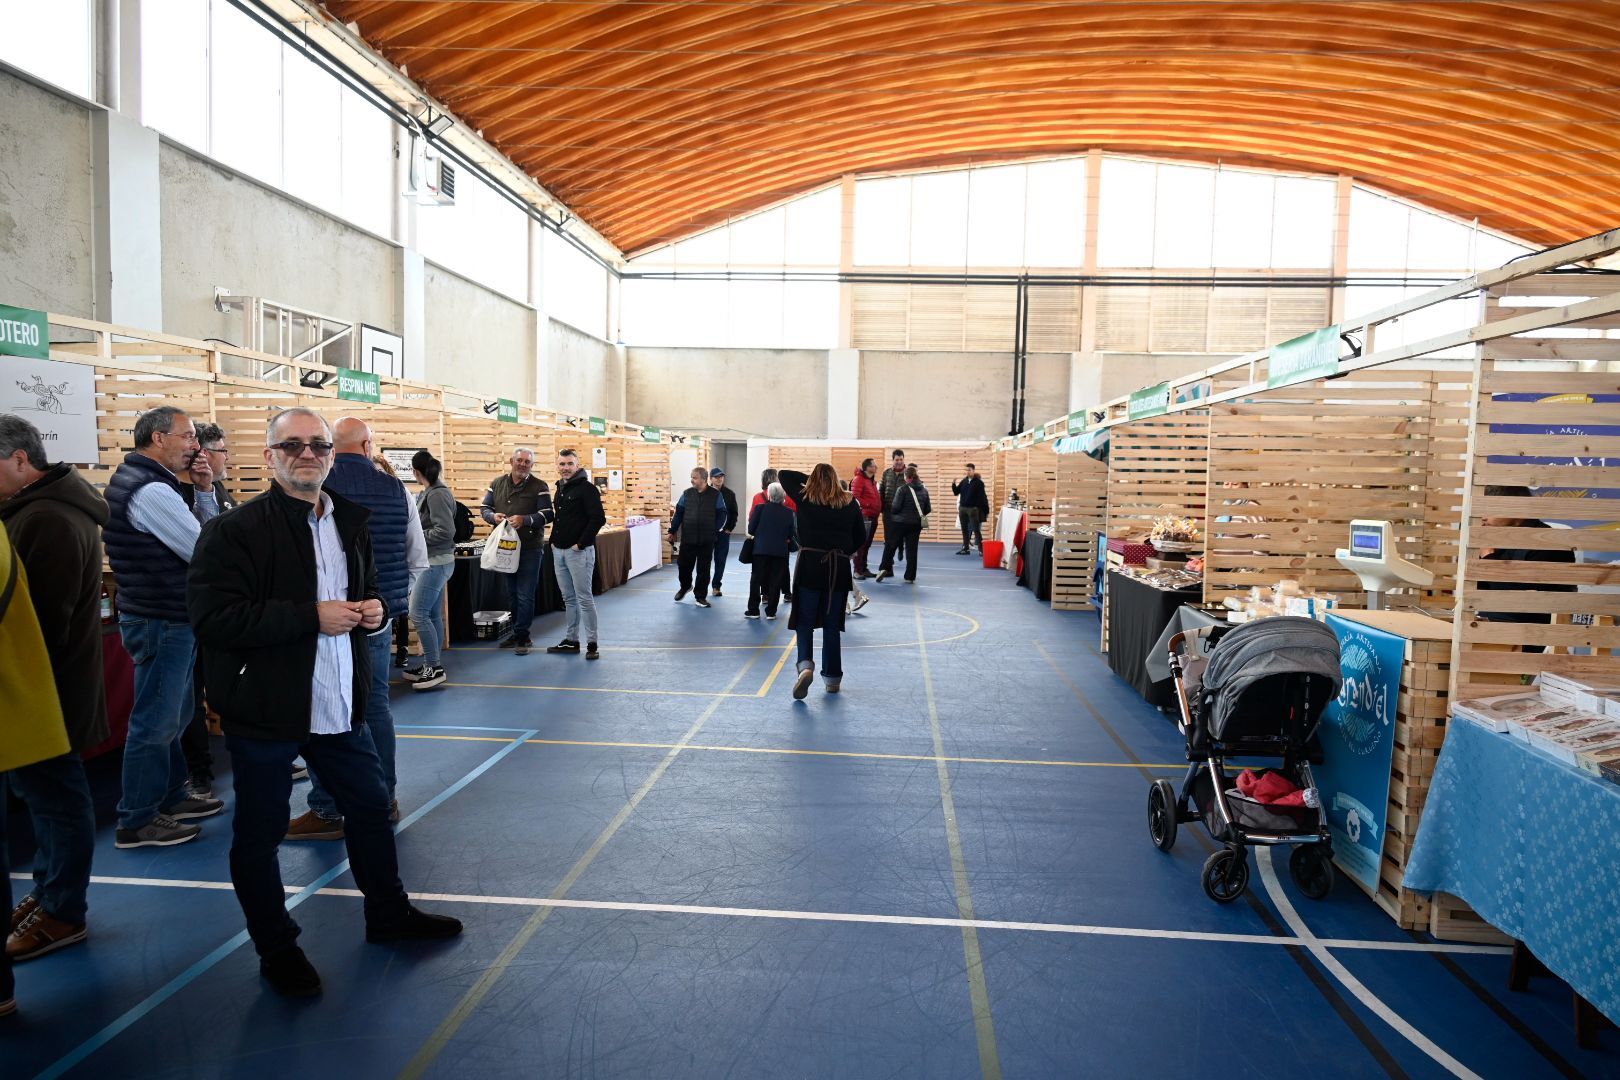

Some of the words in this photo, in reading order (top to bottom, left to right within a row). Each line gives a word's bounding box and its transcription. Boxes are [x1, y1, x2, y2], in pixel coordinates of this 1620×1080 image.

[0, 318, 40, 347] OTERO
[339, 376, 365, 395] RESPINA
[364, 380, 378, 397] MIEL
[41, 429, 58, 441] arín
[1337, 673, 1390, 726] arandiel
